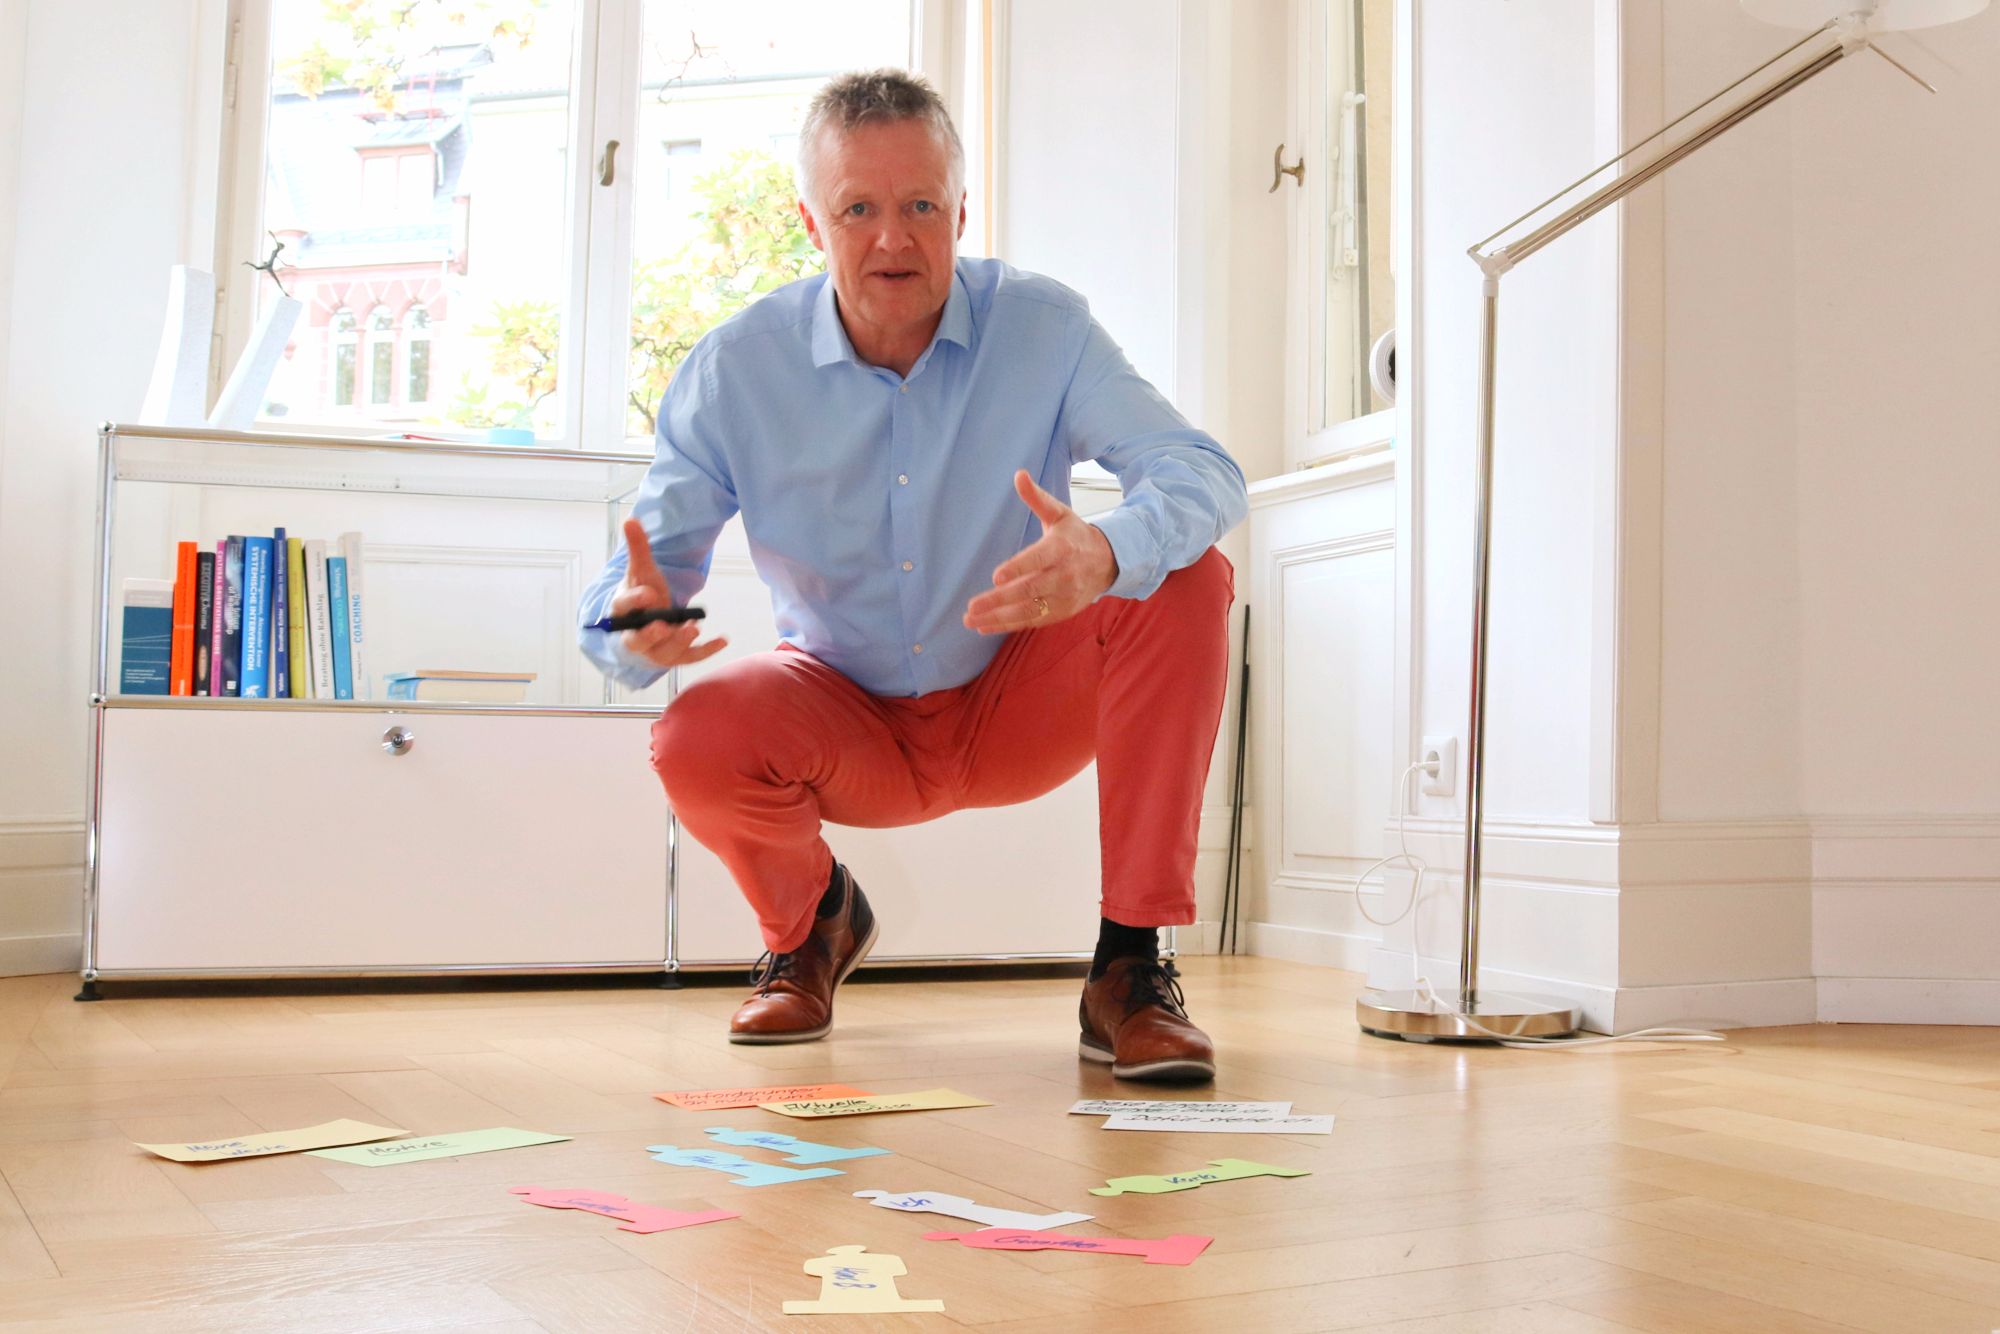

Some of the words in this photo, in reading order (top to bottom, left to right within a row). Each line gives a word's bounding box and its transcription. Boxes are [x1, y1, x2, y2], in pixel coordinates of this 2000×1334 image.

[249, 546, 259, 604] SYSTEMISCHE
[214, 585, 222, 633] ORIENTATIONS
[316, 593, 327, 631] Ratschlag
[352, 594, 363, 644] COACHING
[213, 634, 221, 656] GUIDE
[246, 605, 257, 671] INTERVENTION
[318, 629, 328, 651] ohne
[320, 652, 329, 688] Beratung
[674, 1087, 822, 1100] Anforderungen
[367, 1140, 449, 1155] Motive
